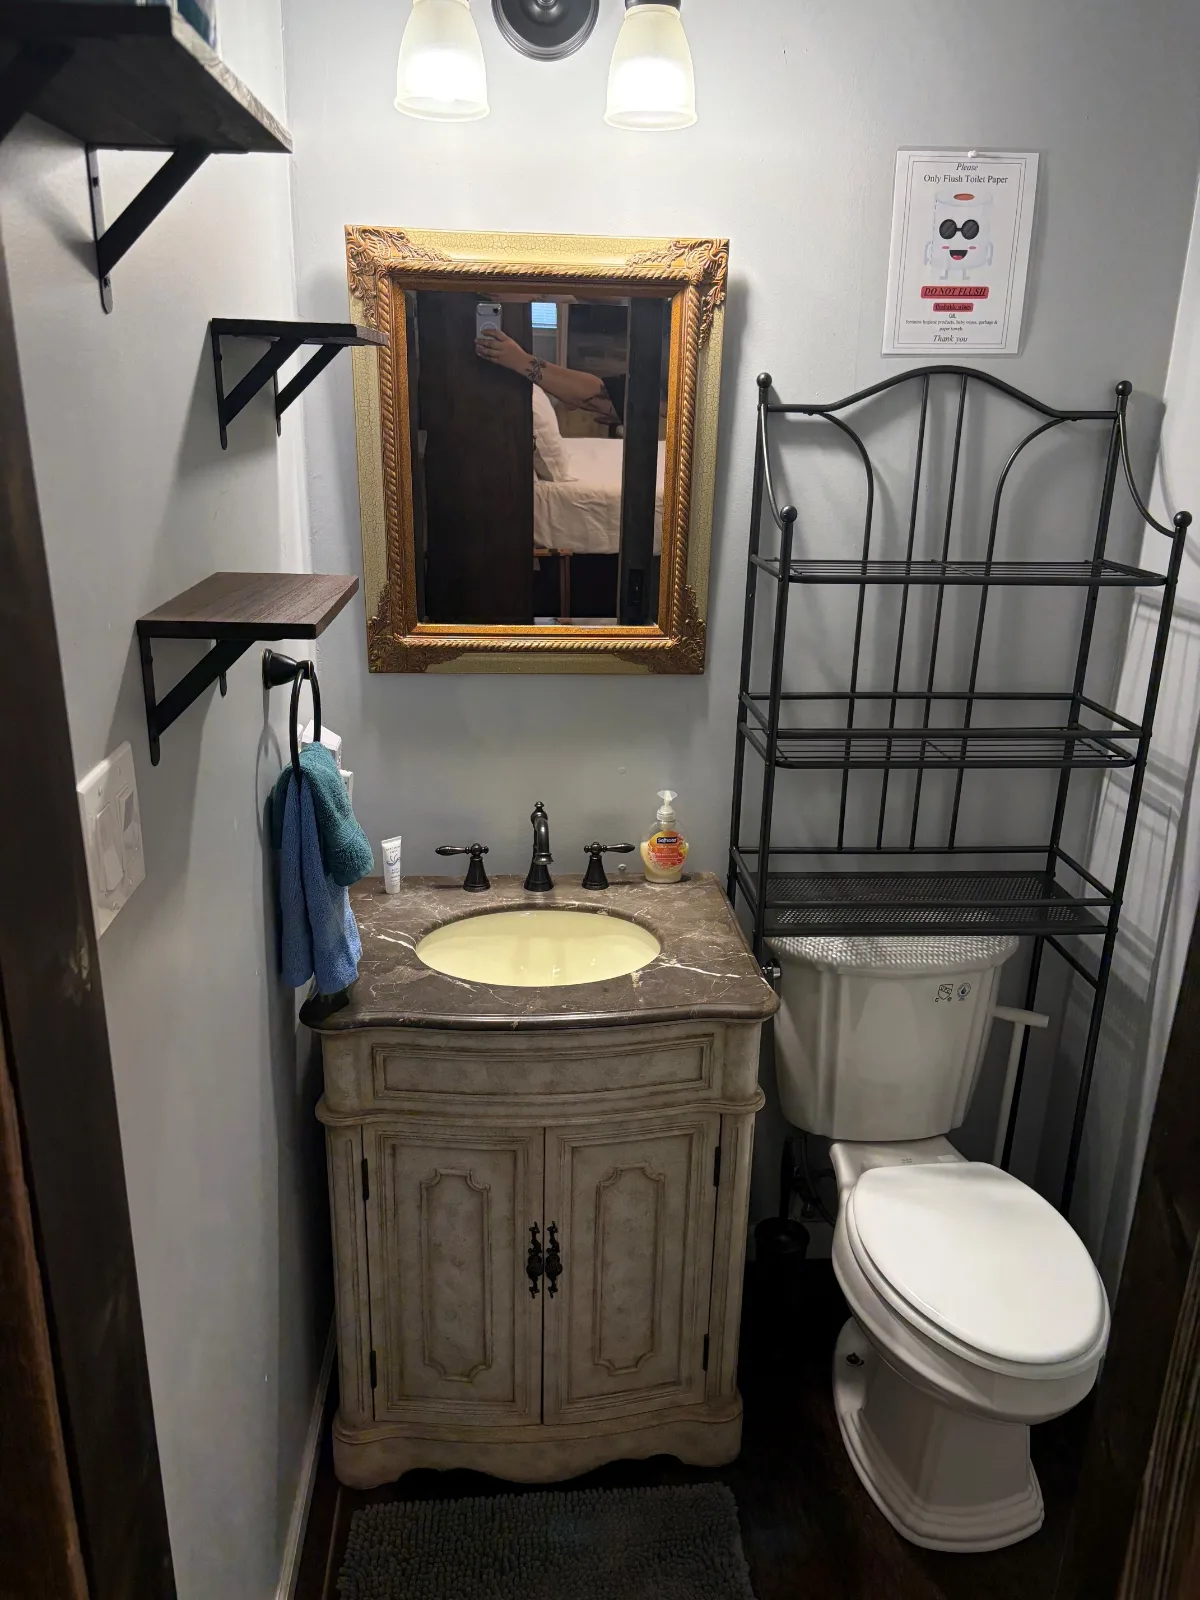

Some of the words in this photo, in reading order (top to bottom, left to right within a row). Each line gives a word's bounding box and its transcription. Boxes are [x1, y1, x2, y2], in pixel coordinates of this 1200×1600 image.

[956, 162, 979, 171] Please
[923, 174, 941, 184] Only
[943, 174, 963, 183] Flush
[965, 175, 986, 184] Toilet
[987, 175, 1009, 185] Paper
[923, 287, 938, 297] DO
[939, 287, 957, 297] NOT
[958, 287, 986, 297] FLUSH
[932, 334, 954, 342] Thank
[954, 336, 968, 344] you
